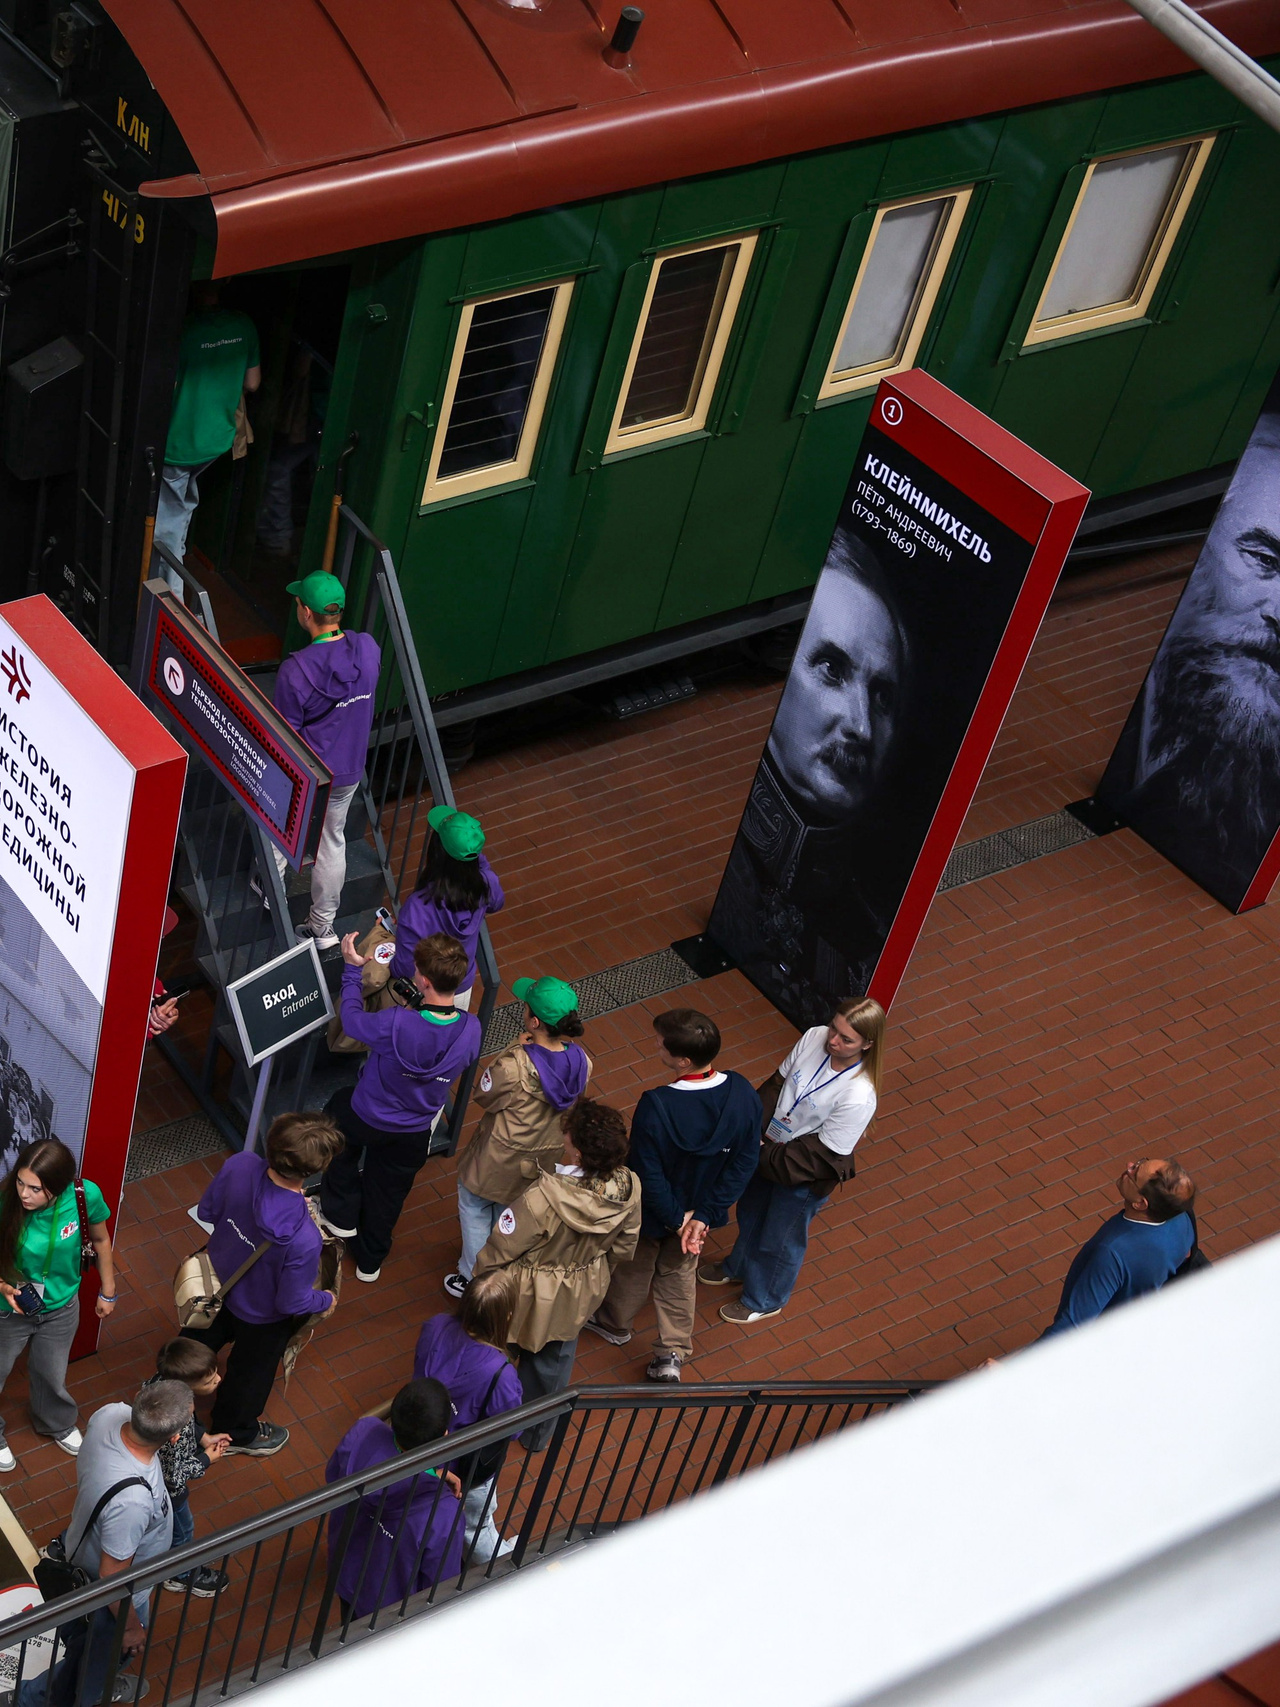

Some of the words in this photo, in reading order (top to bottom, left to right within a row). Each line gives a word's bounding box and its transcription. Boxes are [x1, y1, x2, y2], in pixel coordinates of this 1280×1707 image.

[857, 480, 885, 508] ПЁТР
[885, 502, 953, 562] АНДРЕЕВИЧ
[864, 453, 992, 564] КЛЕЙНМИХЕЛЬ
[190, 691, 263, 779] ТЕПЛОВОЗОСТРОЕНИЮ
[192, 679, 221, 720] ПЕРЕХОД
[221, 714, 227, 725] К
[227, 721, 268, 770] СЕРИЙНОМУ
[230, 761, 260, 797] LOCOMOTIVES
[231, 753, 256, 785] TRANSITION
[262, 790, 277, 810] DIESEL
[262, 983, 297, 1010] Вход
[282, 990, 319, 1018] Entrance
